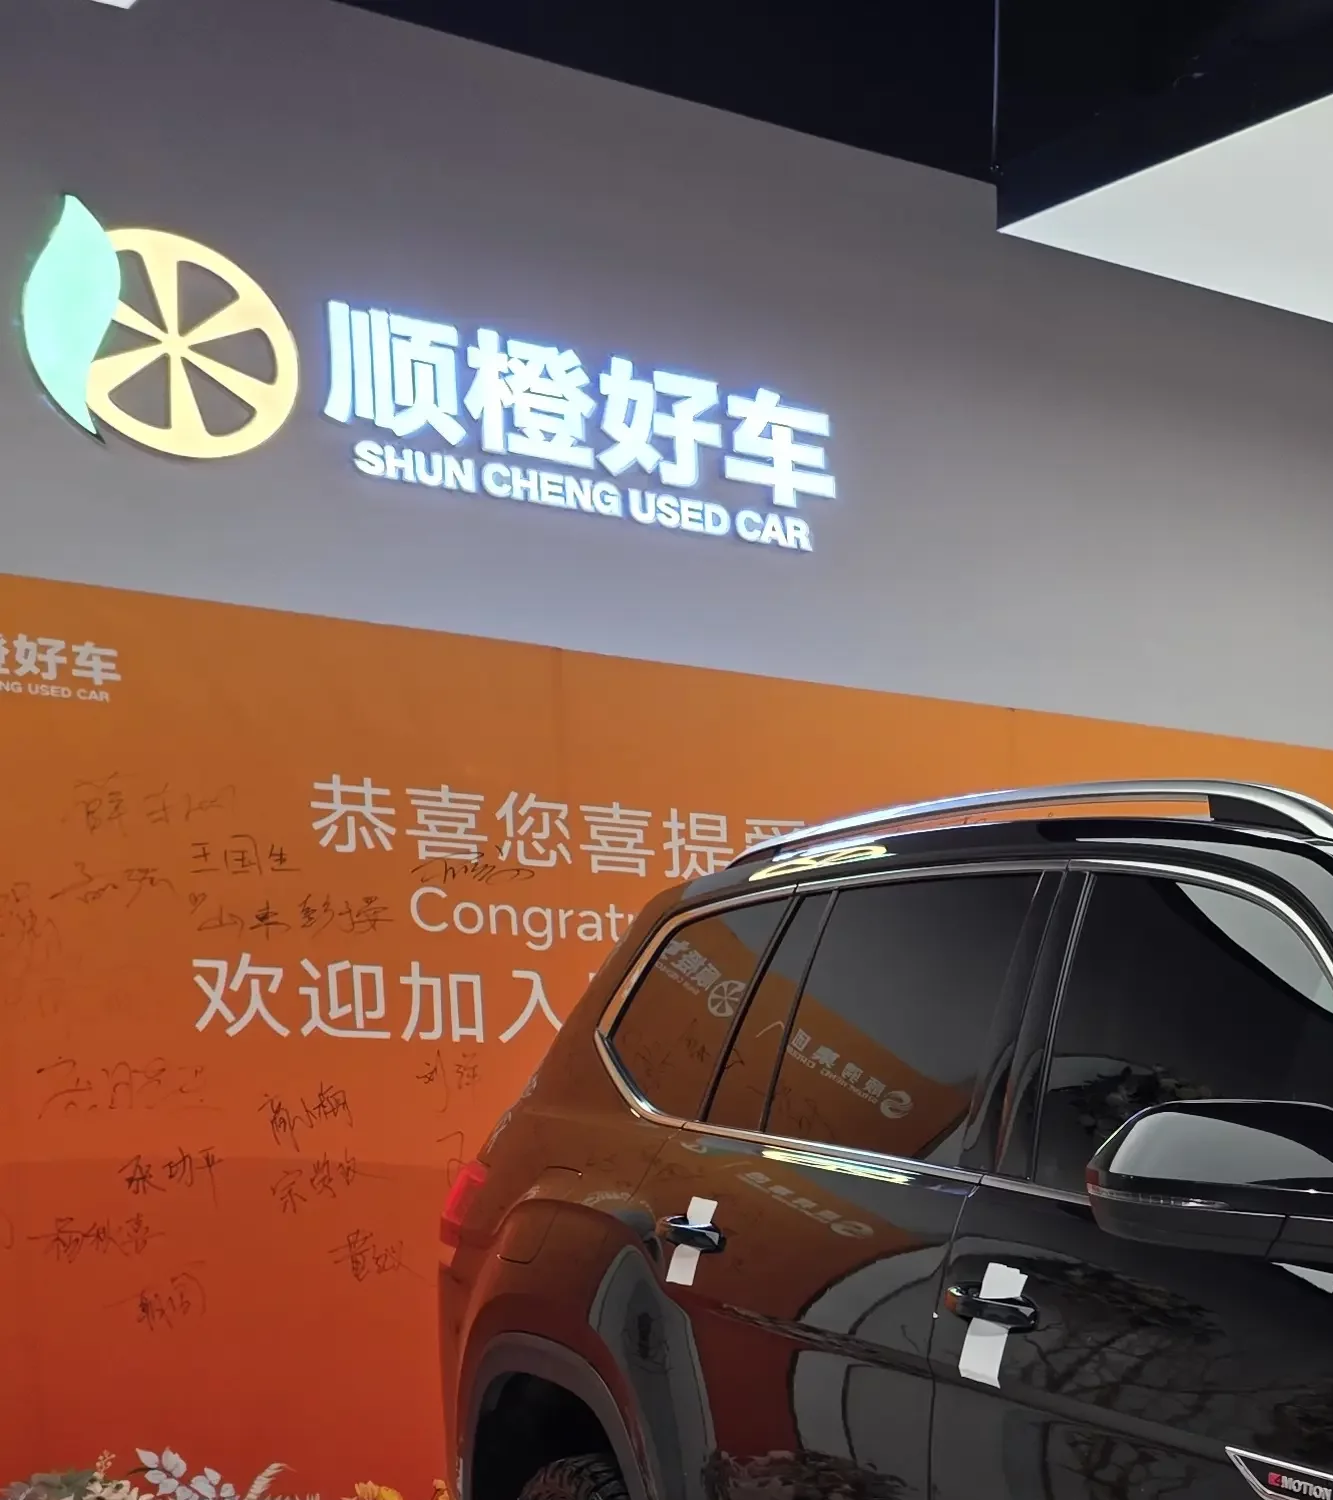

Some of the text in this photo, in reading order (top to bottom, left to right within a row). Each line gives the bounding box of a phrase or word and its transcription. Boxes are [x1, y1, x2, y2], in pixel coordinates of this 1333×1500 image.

[323, 299, 836, 508] 顺橙好车
[353, 440, 813, 552] SHUN CHENG USED CAR
[0, 632, 122, 686] 好车
[28, 683, 72, 698] USED
[77, 688, 110, 703] CAR
